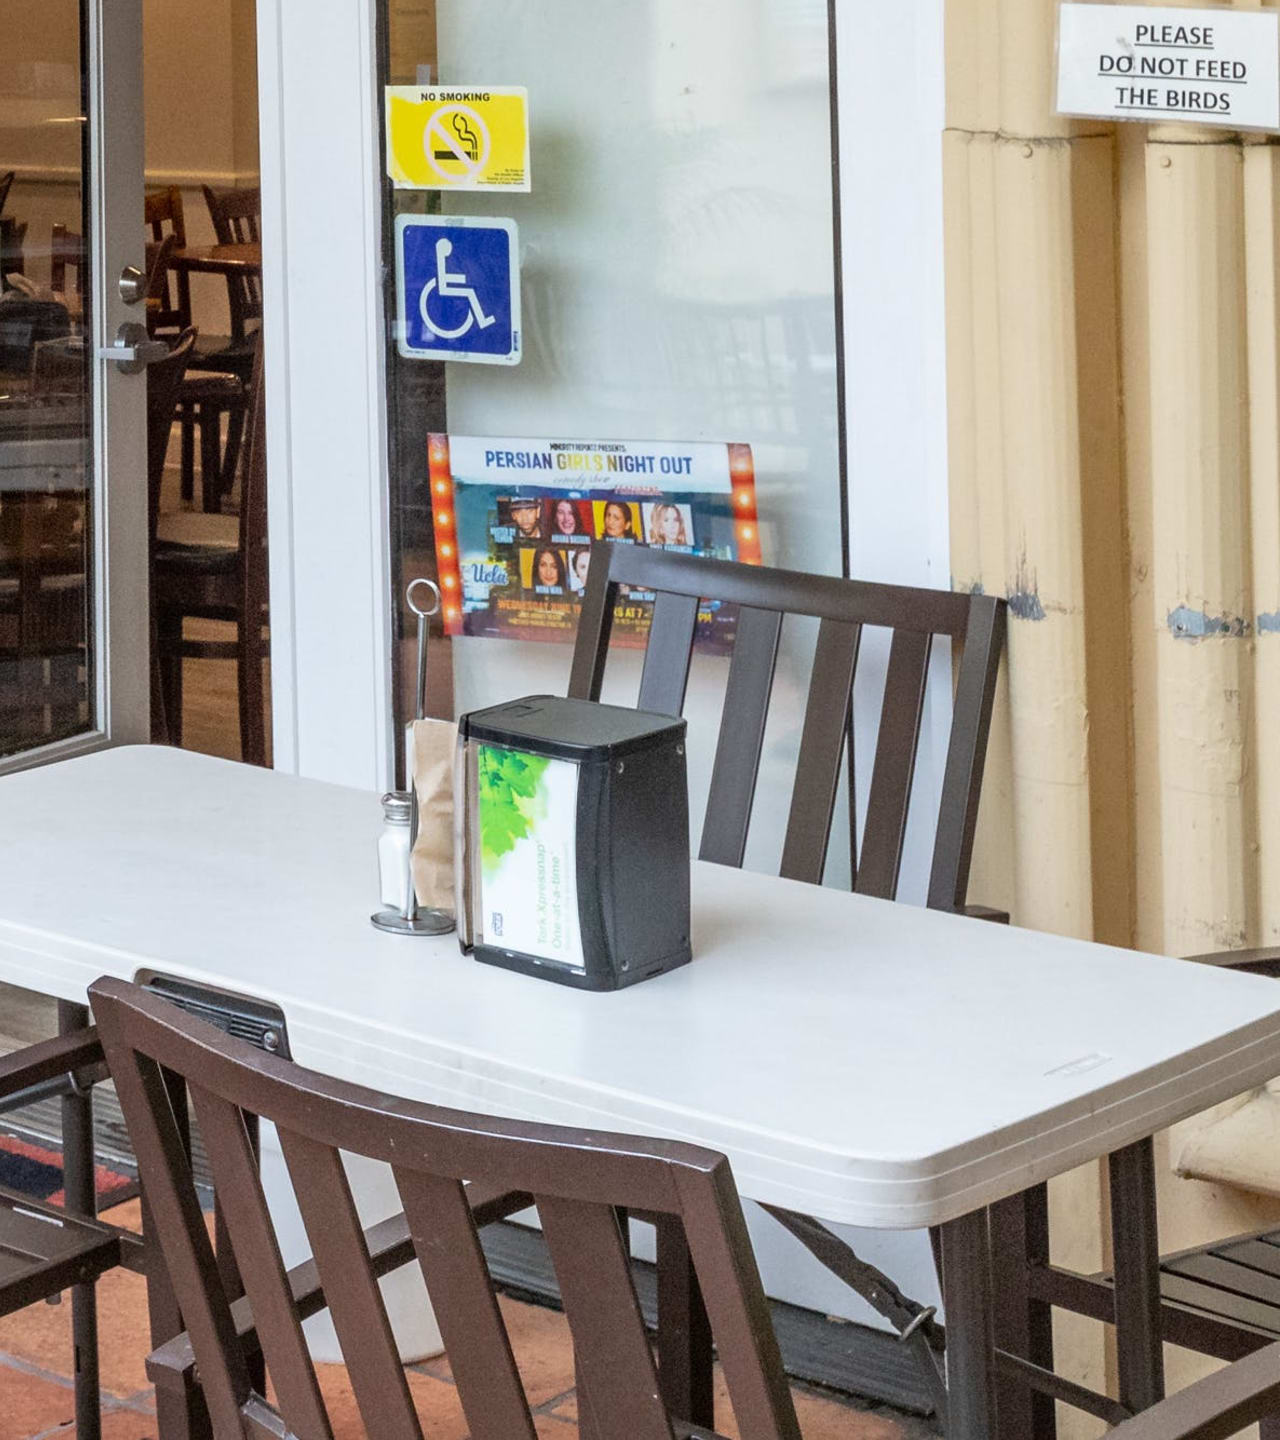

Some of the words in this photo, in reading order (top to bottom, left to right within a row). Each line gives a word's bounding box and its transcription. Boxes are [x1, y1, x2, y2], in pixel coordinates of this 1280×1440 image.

[1134, 23, 1215, 47] PLEASE
[1098, 54, 1134, 74] DO
[1140, 56, 1189, 76] NOT
[1195, 59, 1248, 80] FEED
[420, 92, 436, 102] NO
[439, 92, 491, 103] SMOKING
[1116, 86, 1159, 107] THE
[1166, 89, 1231, 111] BIRDS
[485, 450, 553, 471] PERSIAN
[556, 453, 604, 472] GIRLS
[607, 454, 655, 474] NIGHT
[660, 456, 693, 476] OUT
